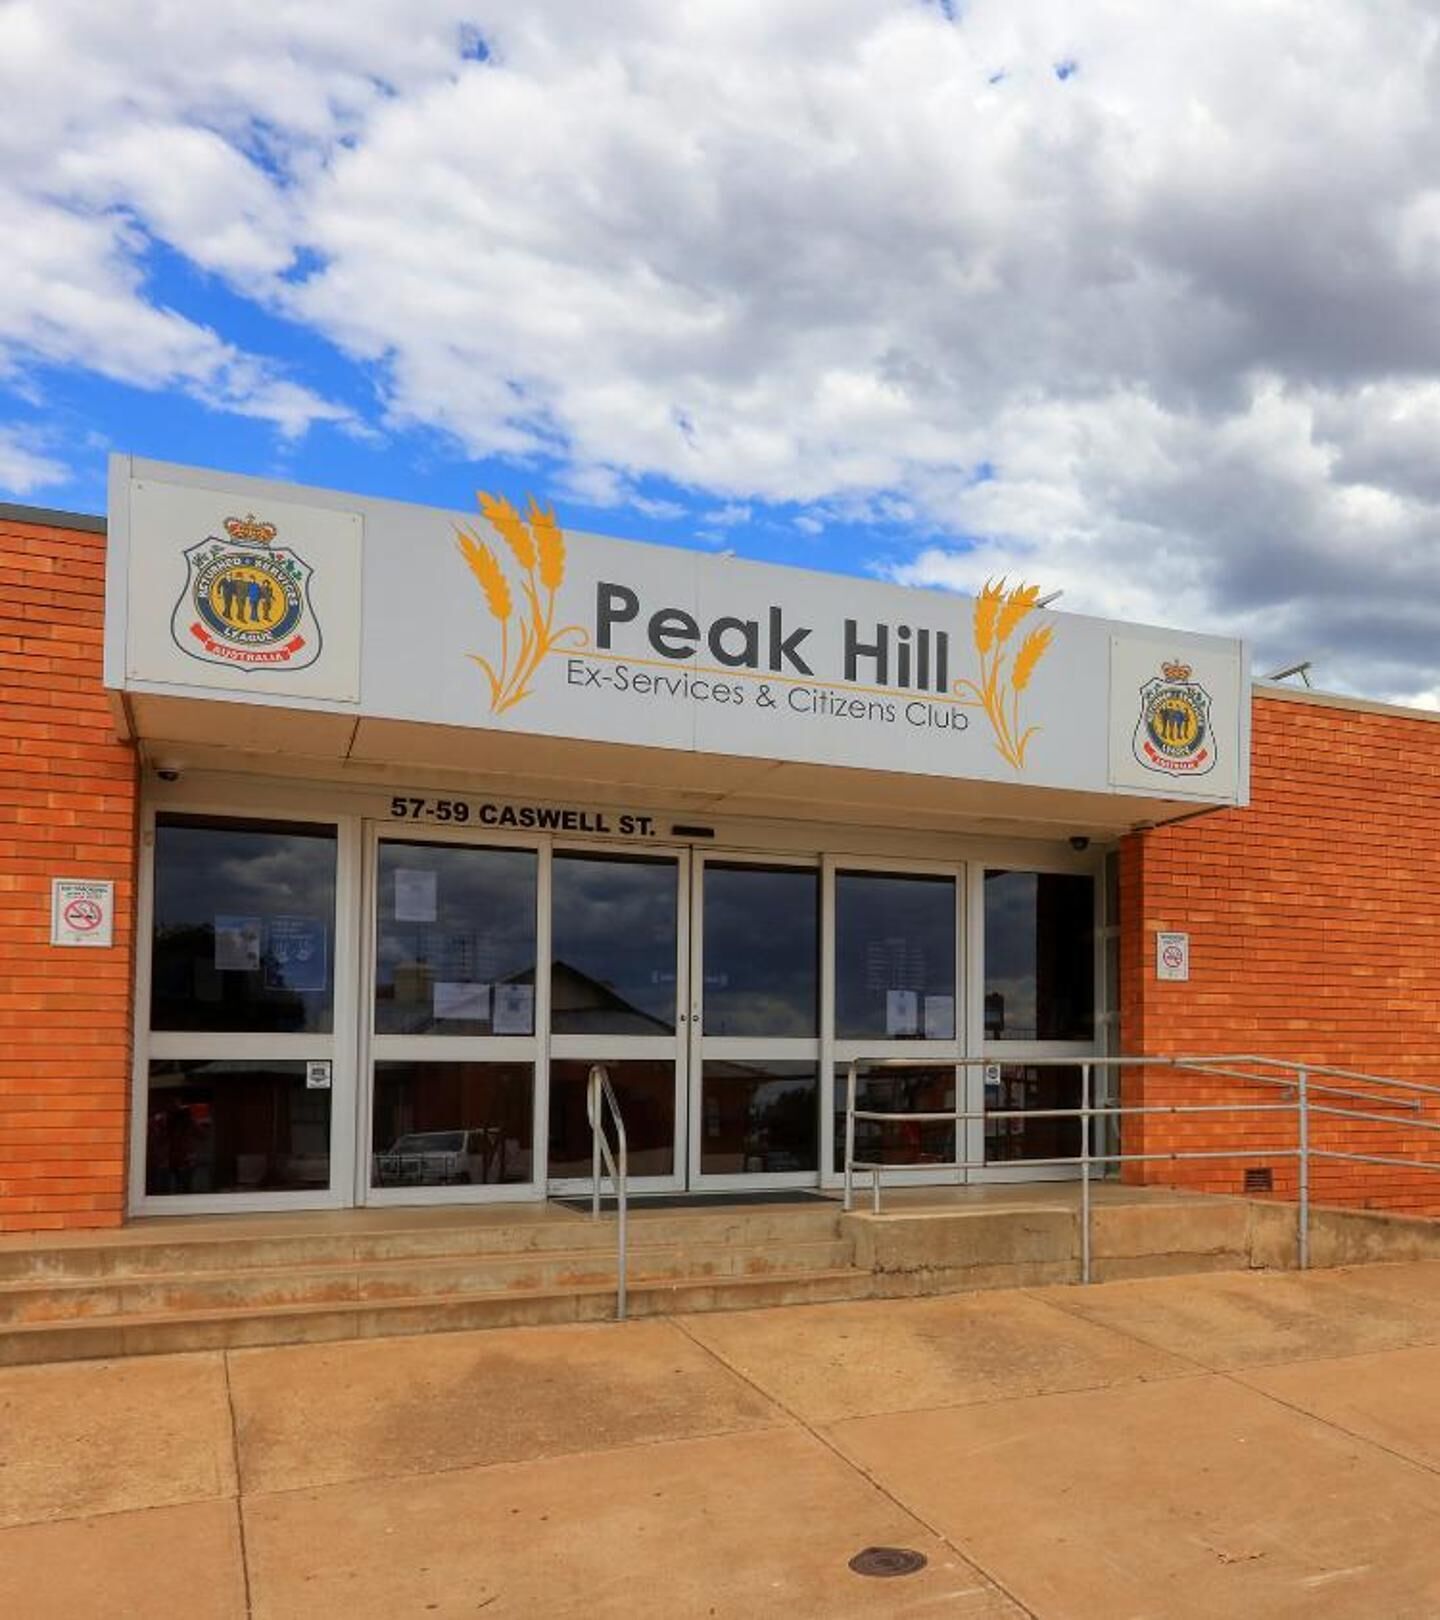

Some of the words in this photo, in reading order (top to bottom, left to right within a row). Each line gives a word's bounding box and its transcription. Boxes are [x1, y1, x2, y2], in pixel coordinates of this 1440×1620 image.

[596, 581, 814, 676] Peak
[844, 618, 949, 693] Hill
[567, 659, 745, 705] Ex-Services
[755, 684, 777, 709] &
[788, 686, 896, 722] Citizens
[905, 701, 969, 731] Club
[391, 797, 469, 822] 57-59
[479, 803, 610, 832] CASWELL
[619, 815, 656, 836] ST.
